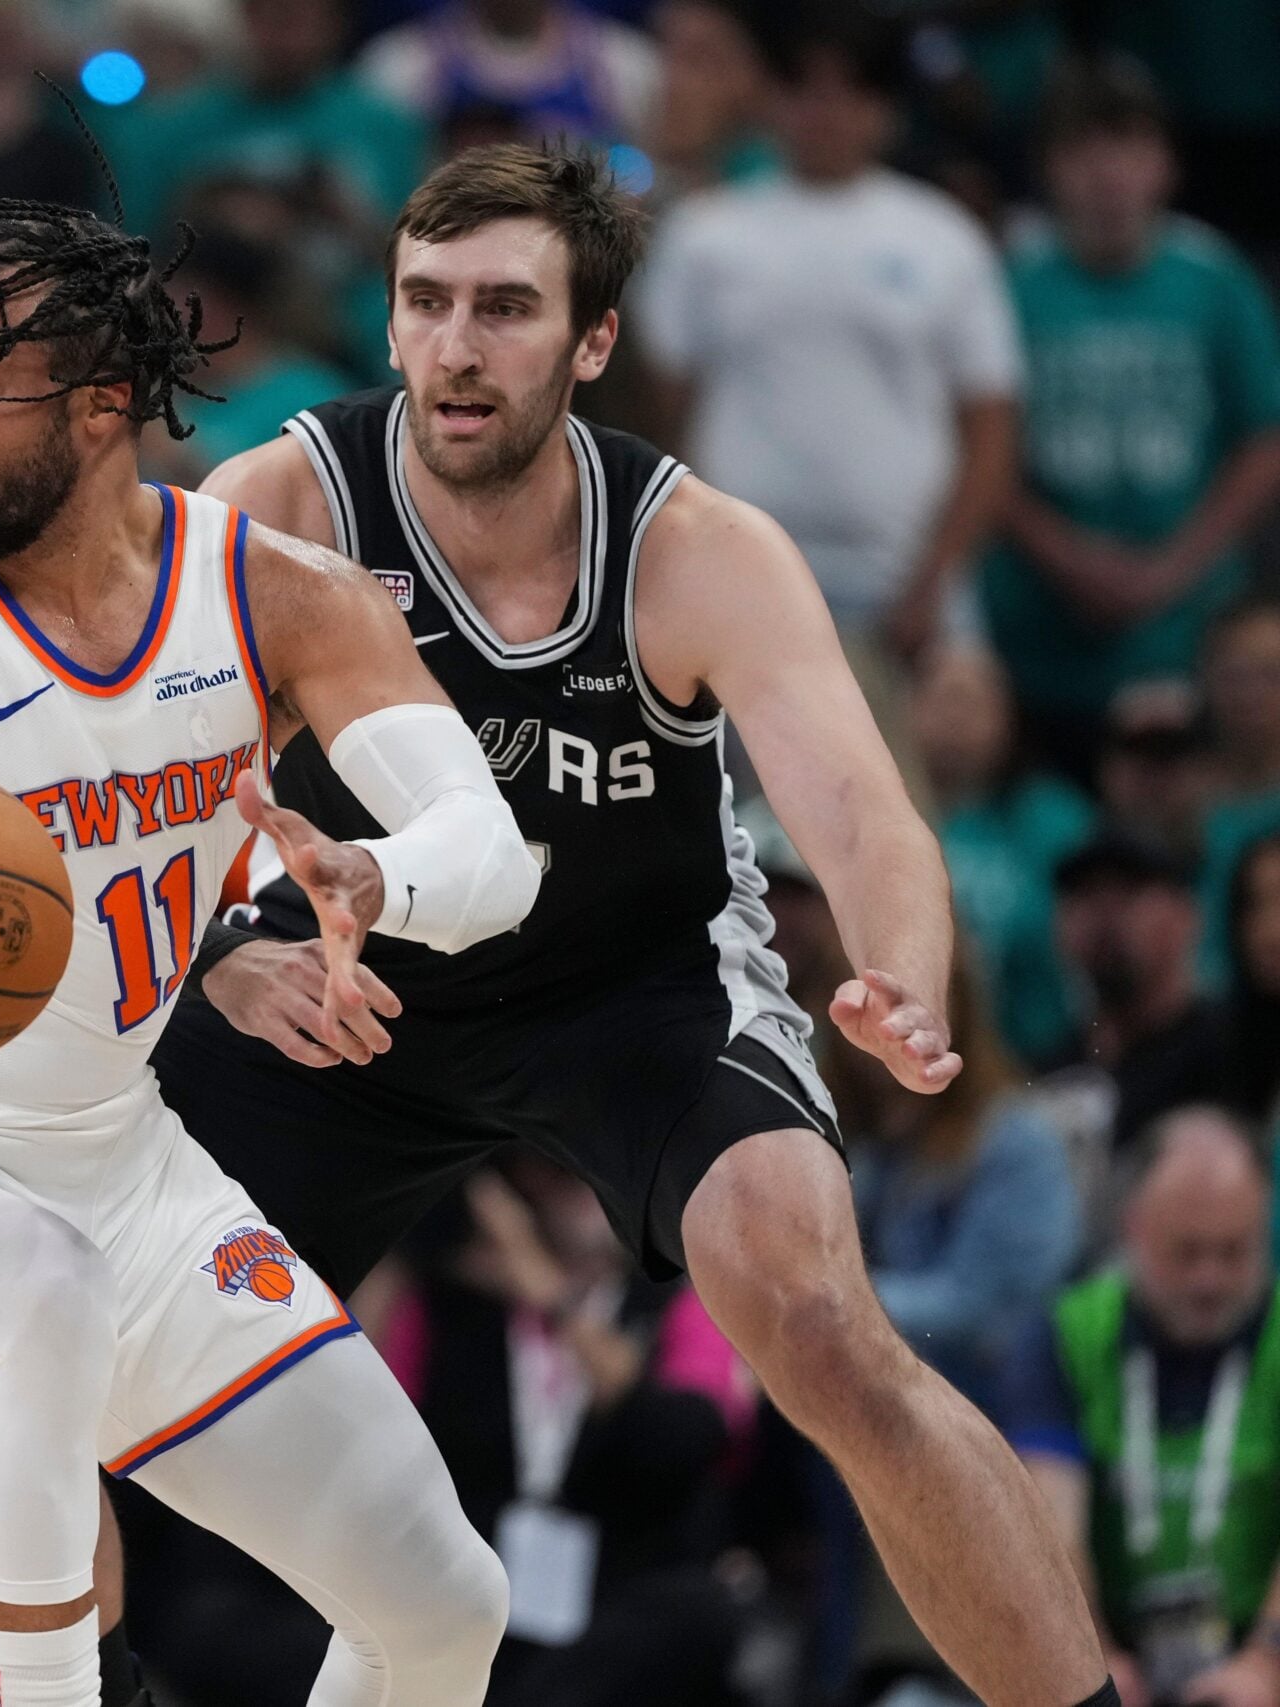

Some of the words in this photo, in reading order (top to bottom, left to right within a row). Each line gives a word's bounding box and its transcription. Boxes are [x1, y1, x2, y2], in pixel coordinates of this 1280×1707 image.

[156, 683, 188, 701] abu
[189, 664, 239, 693] dhabi
[569, 673, 627, 692] LEDGER
[476, 717, 657, 806] URS
[95, 846, 196, 1036] 11
